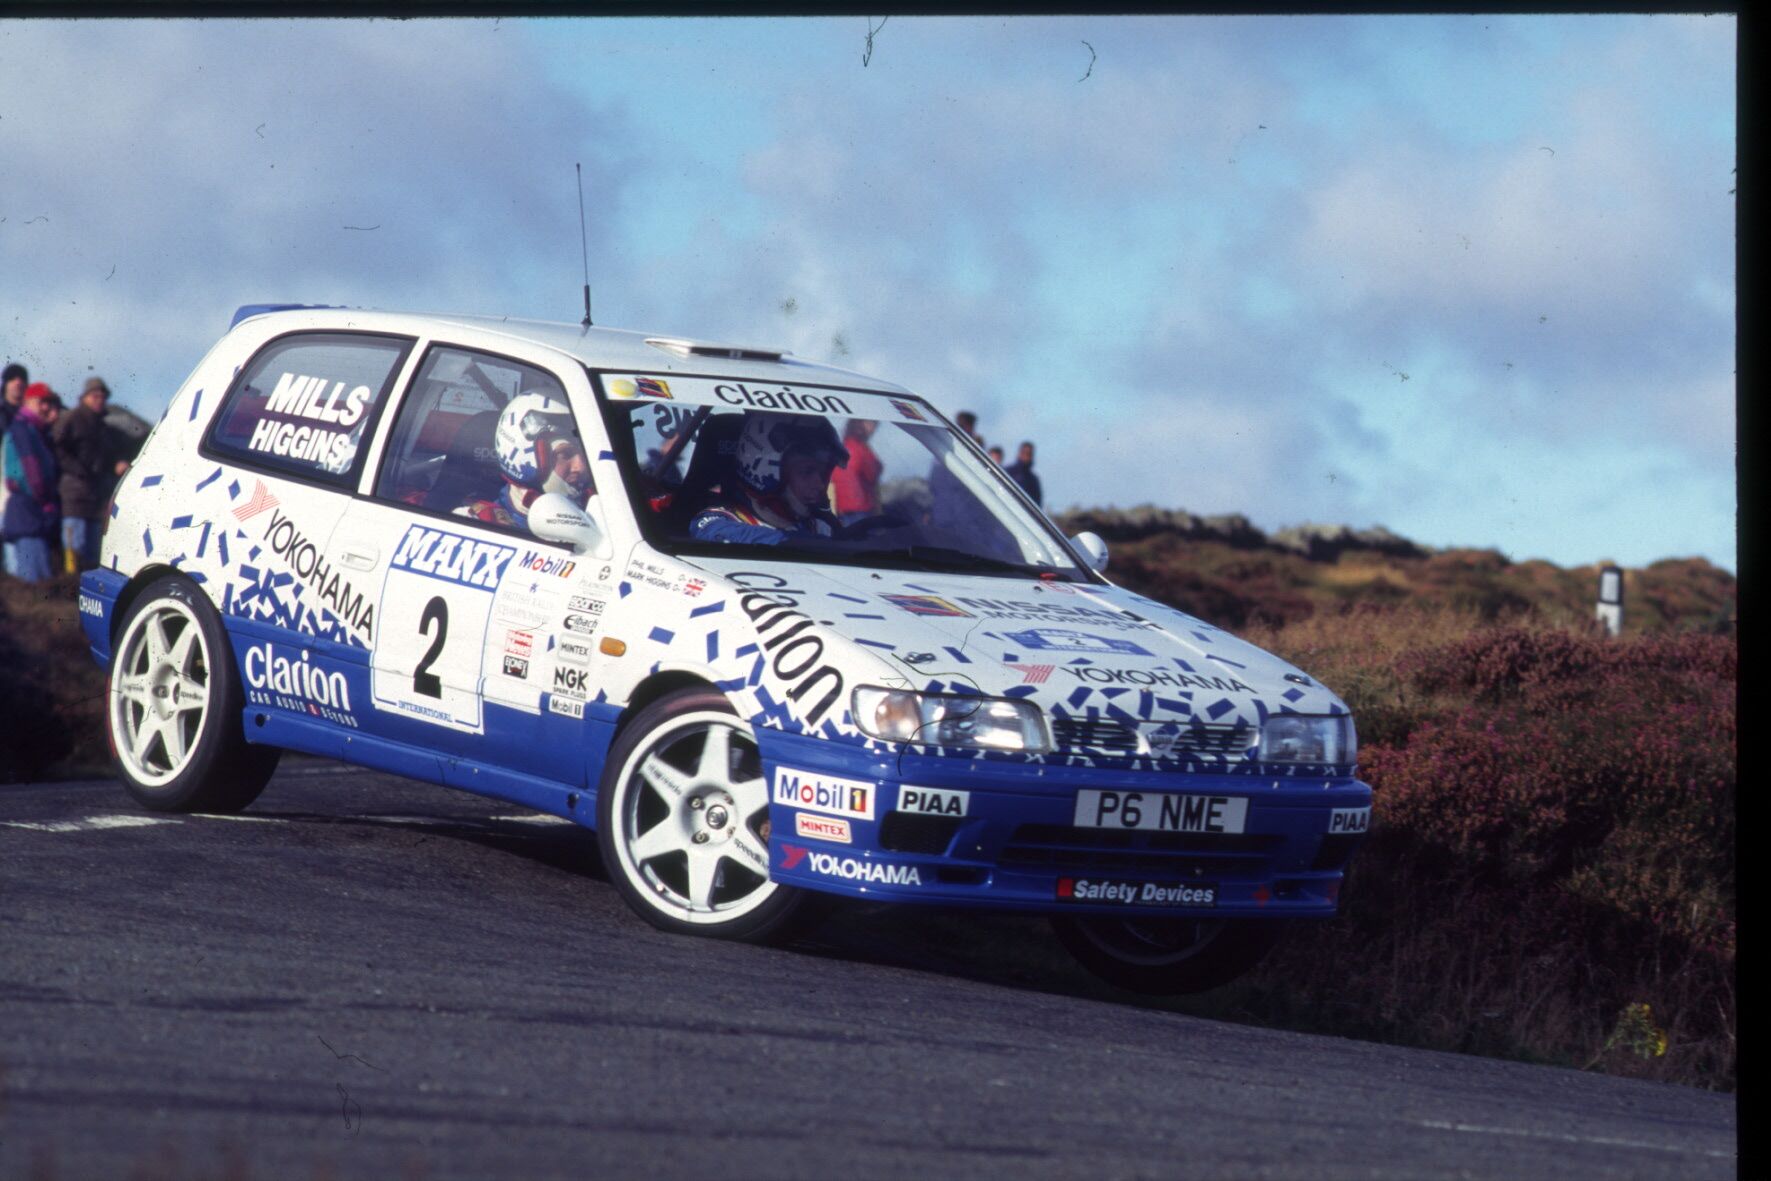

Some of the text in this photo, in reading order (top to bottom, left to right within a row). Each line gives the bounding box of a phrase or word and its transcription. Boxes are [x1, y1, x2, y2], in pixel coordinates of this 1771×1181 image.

[265, 372, 371, 426] MILLS
[714, 383, 852, 415] Clarion
[248, 418, 350, 466] HIGGINS
[393, 526, 515, 589] MANX
[519, 550, 577, 578] Mobil 1
[263, 508, 374, 642] YOKOHAMA
[954, 597, 1146, 622] NISSAN
[413, 596, 449, 700] 2
[561, 643, 589, 656] MINTEX
[725, 571, 843, 726] Clarion
[246, 643, 351, 712] Clarion
[553, 666, 589, 692] NGK
[1060, 666, 1259, 694] YOKOHAMA
[779, 774, 866, 813] Mobil 1
[901, 790, 963, 816] PIAA
[800, 820, 845, 837] MINTEX
[1096, 792, 1228, 833] P6 NME
[1332, 813, 1368, 832] PIAA
[808, 851, 922, 886] YOKOHAMA
[1074, 880, 1215, 904] Safety Devices
